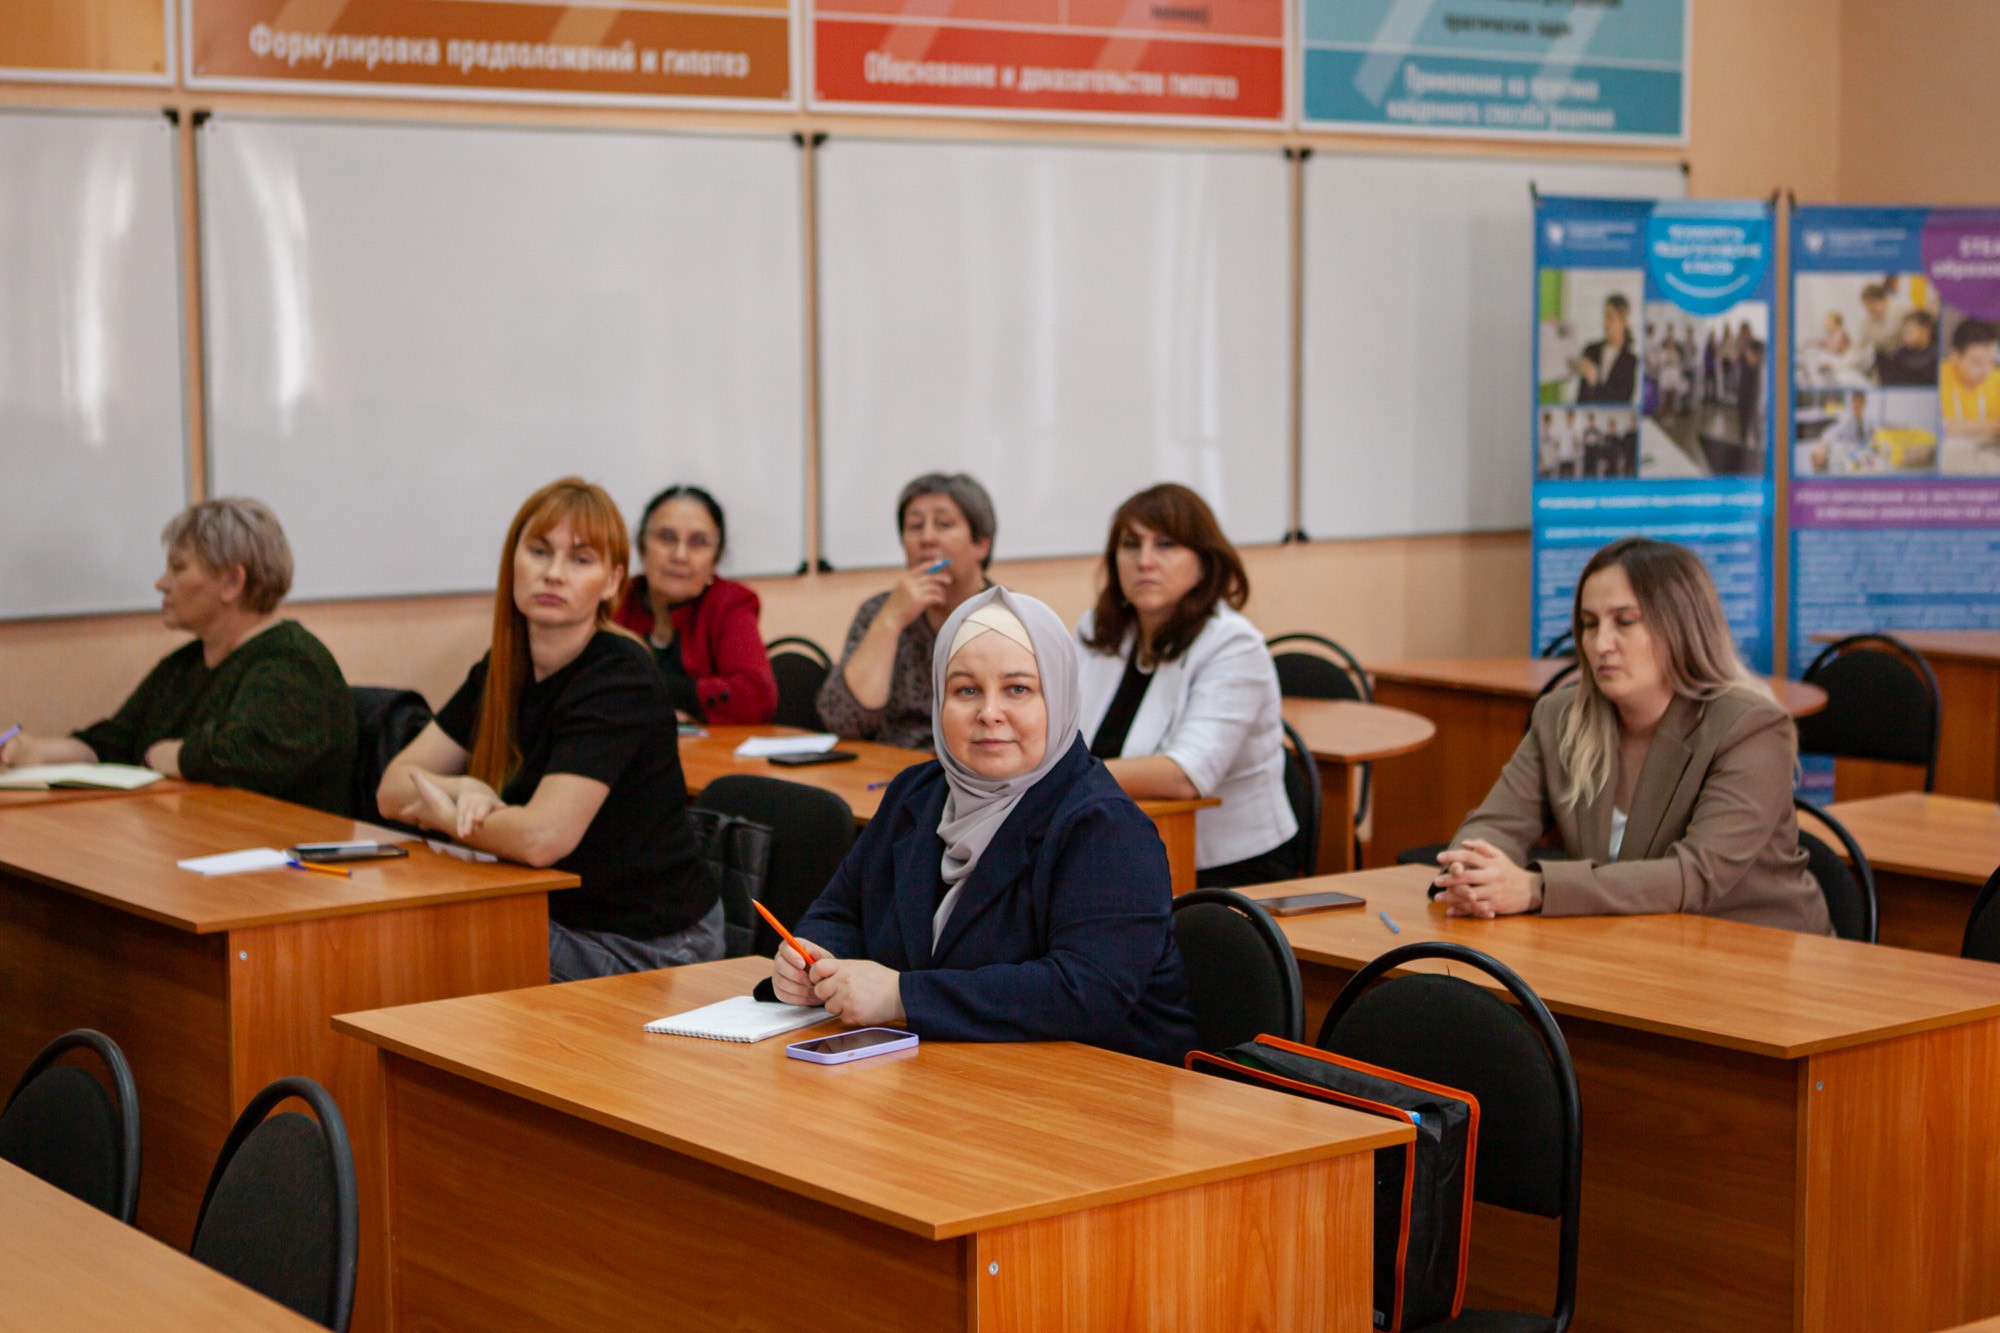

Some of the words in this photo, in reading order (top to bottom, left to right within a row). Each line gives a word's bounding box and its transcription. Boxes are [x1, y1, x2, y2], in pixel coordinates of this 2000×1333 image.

[250, 23, 439, 70] Формулировка
[447, 38, 635, 75] предположений
[640, 48, 657, 74] и
[662, 49, 748, 78] гипотез
